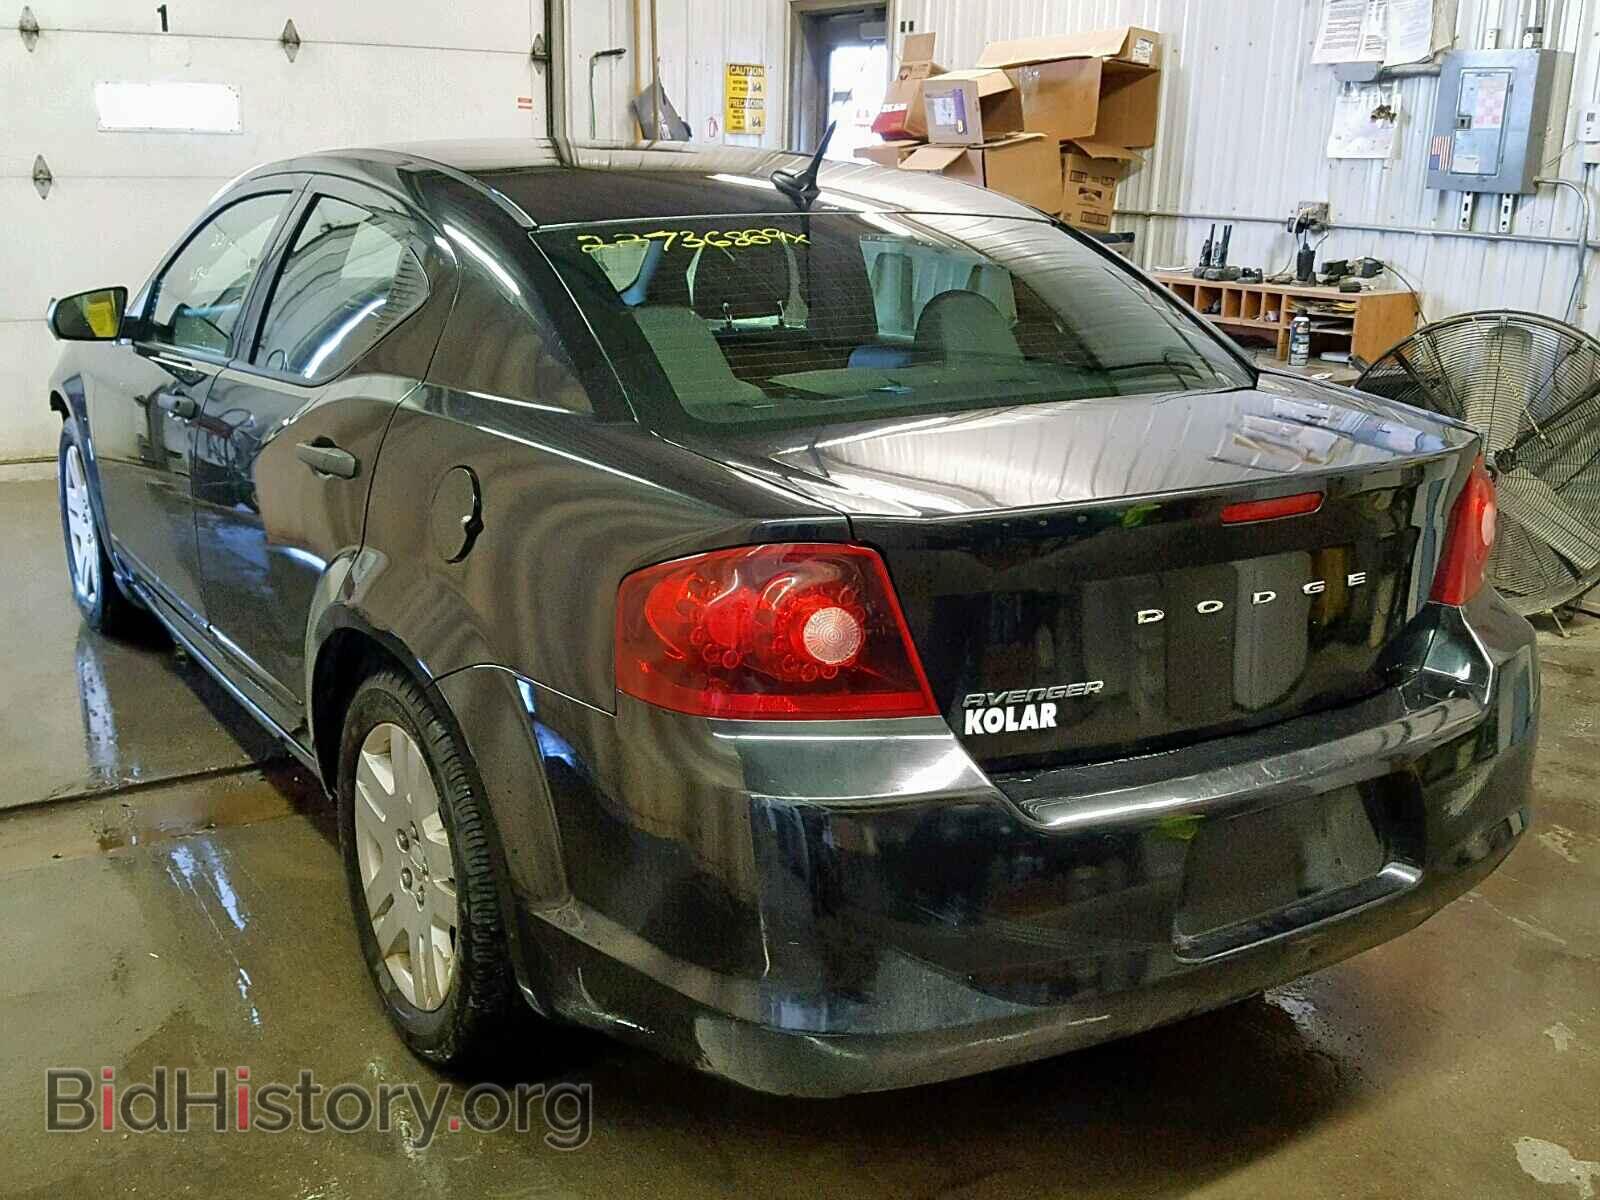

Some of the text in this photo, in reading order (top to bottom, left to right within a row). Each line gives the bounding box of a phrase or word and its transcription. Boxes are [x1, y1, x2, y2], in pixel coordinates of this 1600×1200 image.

[156, 4, 169, 33] 1
[1137, 571, 1367, 625] DODGE
[961, 680, 1104, 708] AVENGER
[964, 702, 1057, 735] KOLAR
